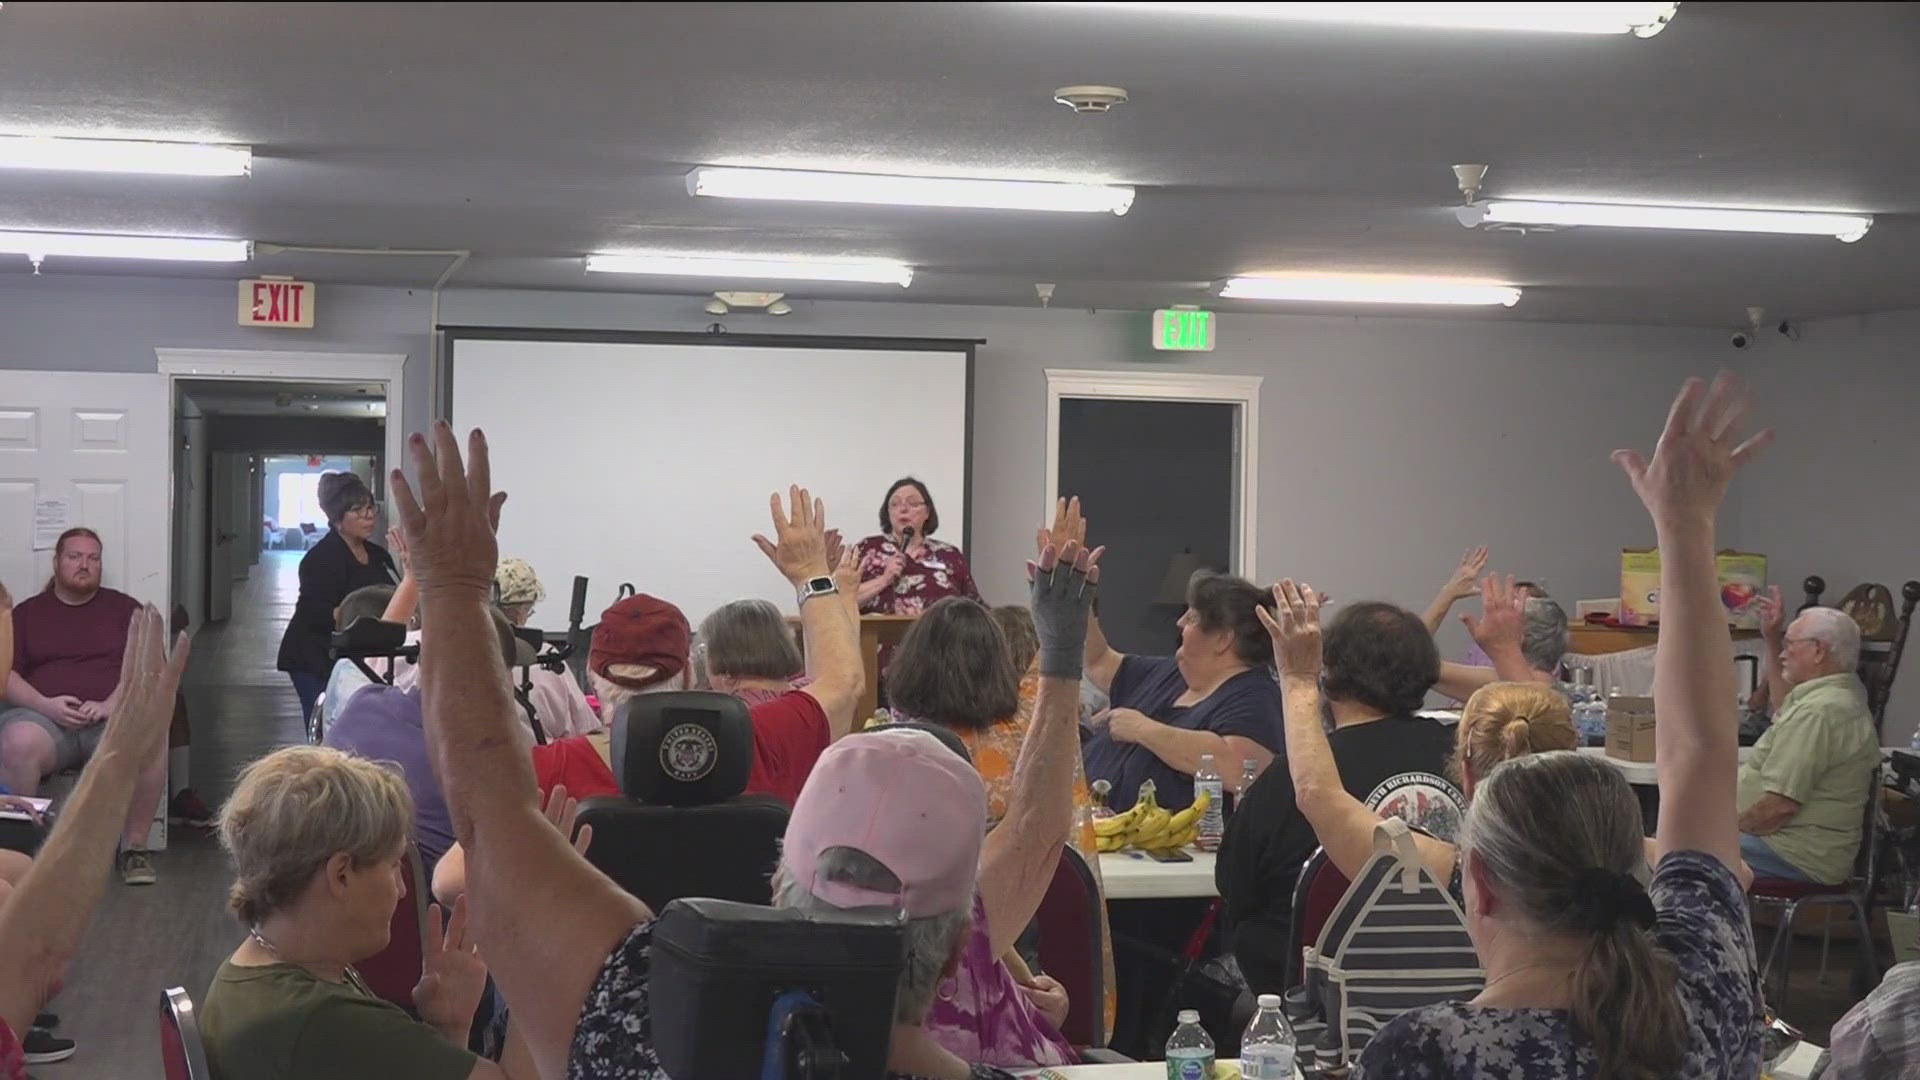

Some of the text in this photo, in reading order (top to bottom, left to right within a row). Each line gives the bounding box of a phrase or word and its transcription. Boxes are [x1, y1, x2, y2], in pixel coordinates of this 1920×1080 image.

[253, 283, 304, 322] EXIT
[1164, 311, 1209, 349] EXIT
[1386, 775, 1447, 790] RICHARDSON
